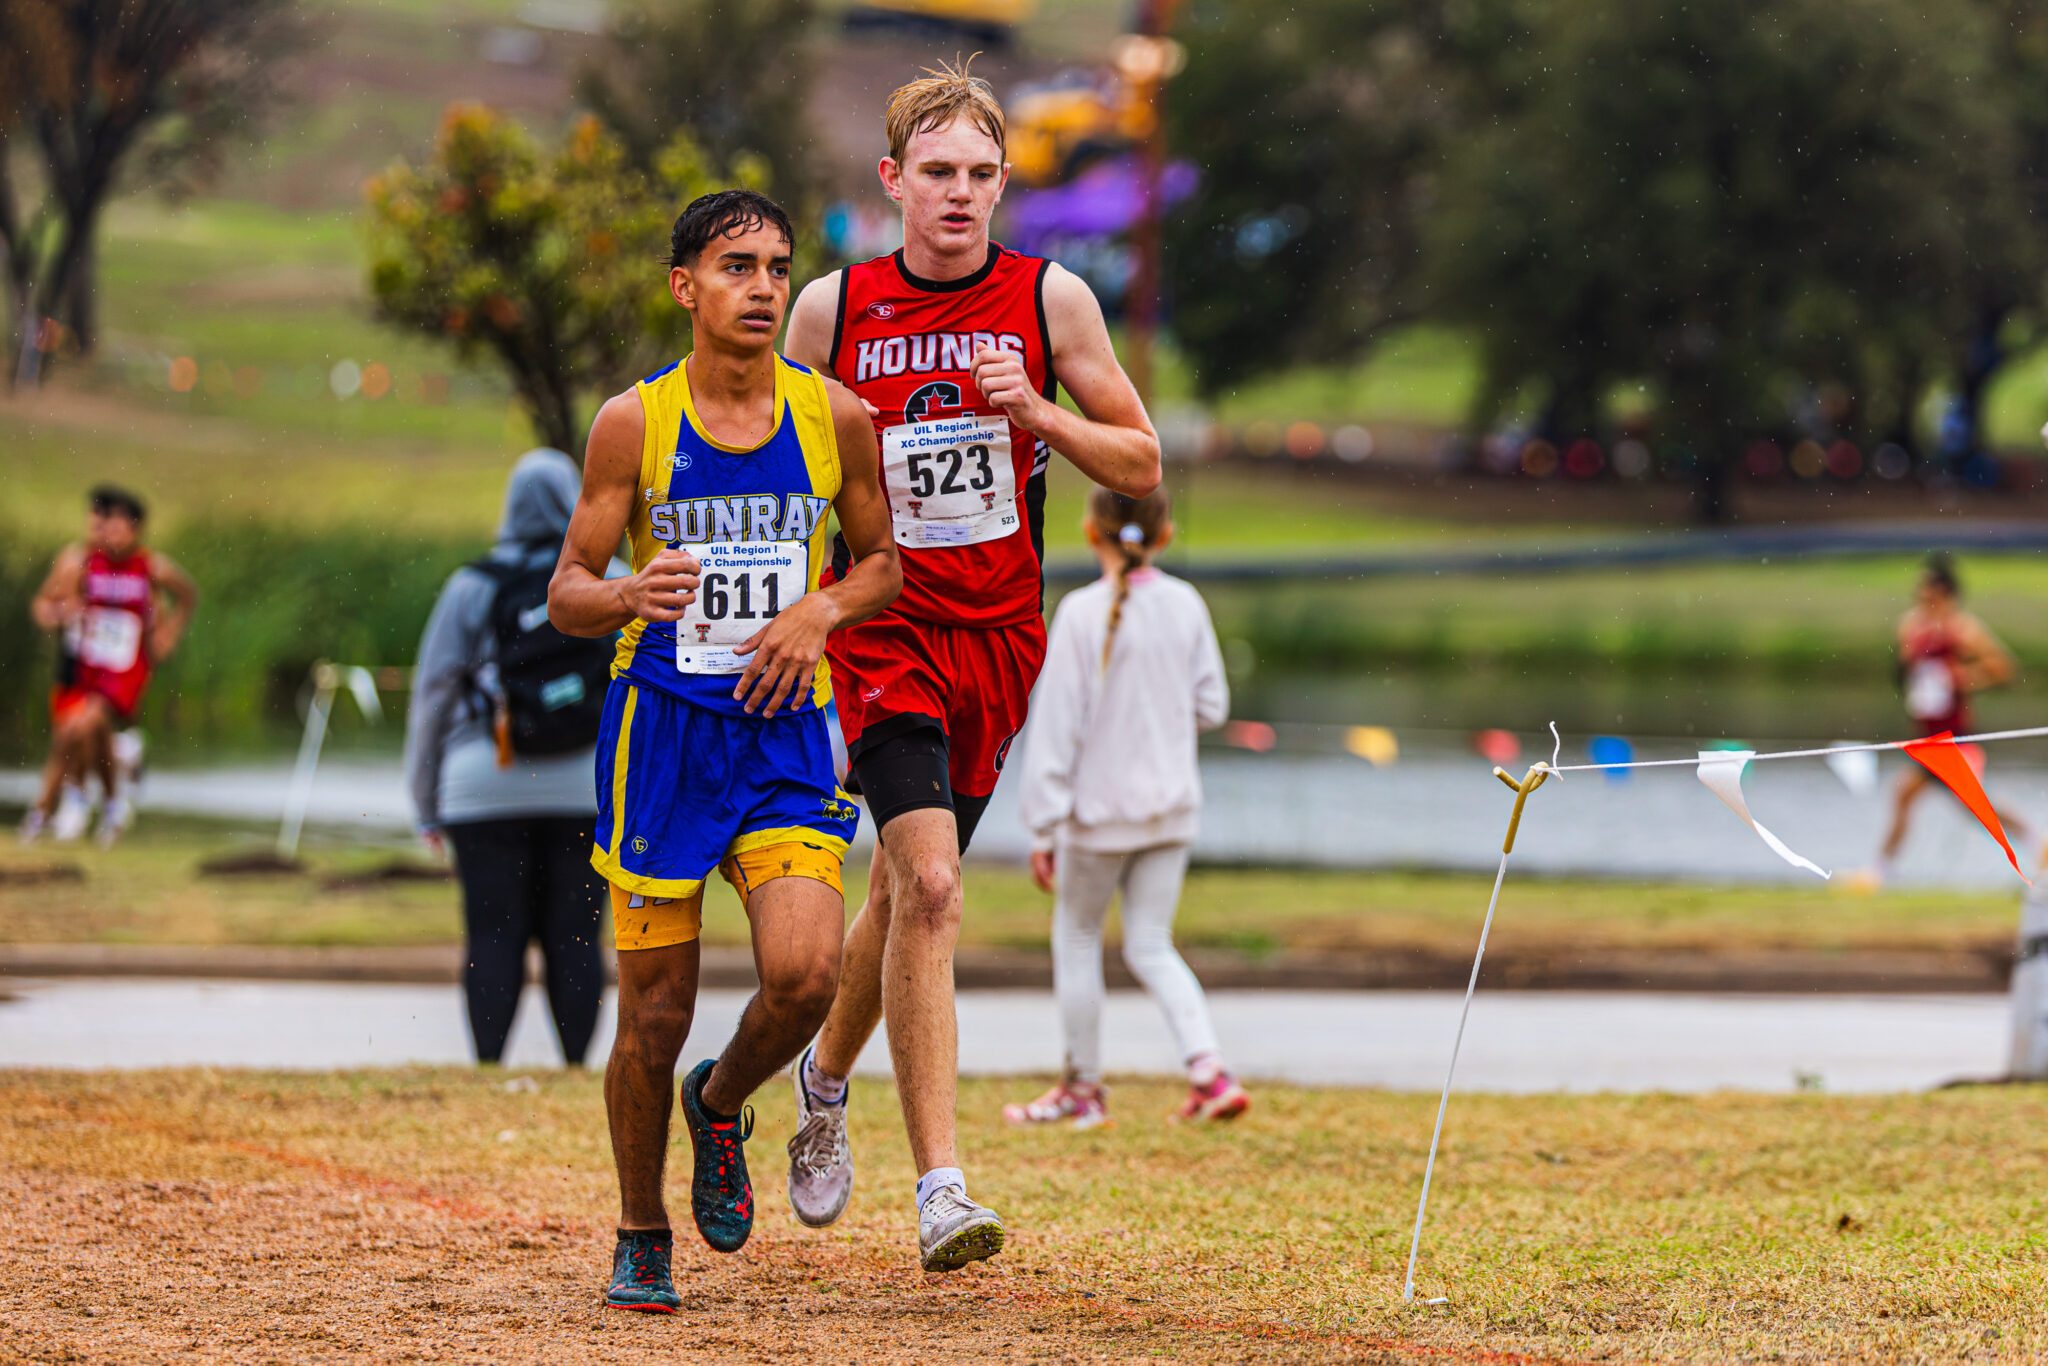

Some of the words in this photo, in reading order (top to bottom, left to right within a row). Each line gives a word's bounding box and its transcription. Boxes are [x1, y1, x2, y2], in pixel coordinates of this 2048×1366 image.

[913, 425, 933, 435] UIL
[935, 422, 973, 433] Region
[975, 420, 979, 429] I
[900, 439, 916, 448] XC
[918, 431, 994, 446] Championship
[906, 445, 994, 498] 523
[650, 494, 829, 542] SUNRAY
[1001, 515, 1016, 525] 523
[711, 546, 730, 555] UIL
[733, 545, 771, 555] Region
[774, 545, 778, 553] I
[714, 557, 792, 568] Championship
[703, 572, 782, 620] 611
